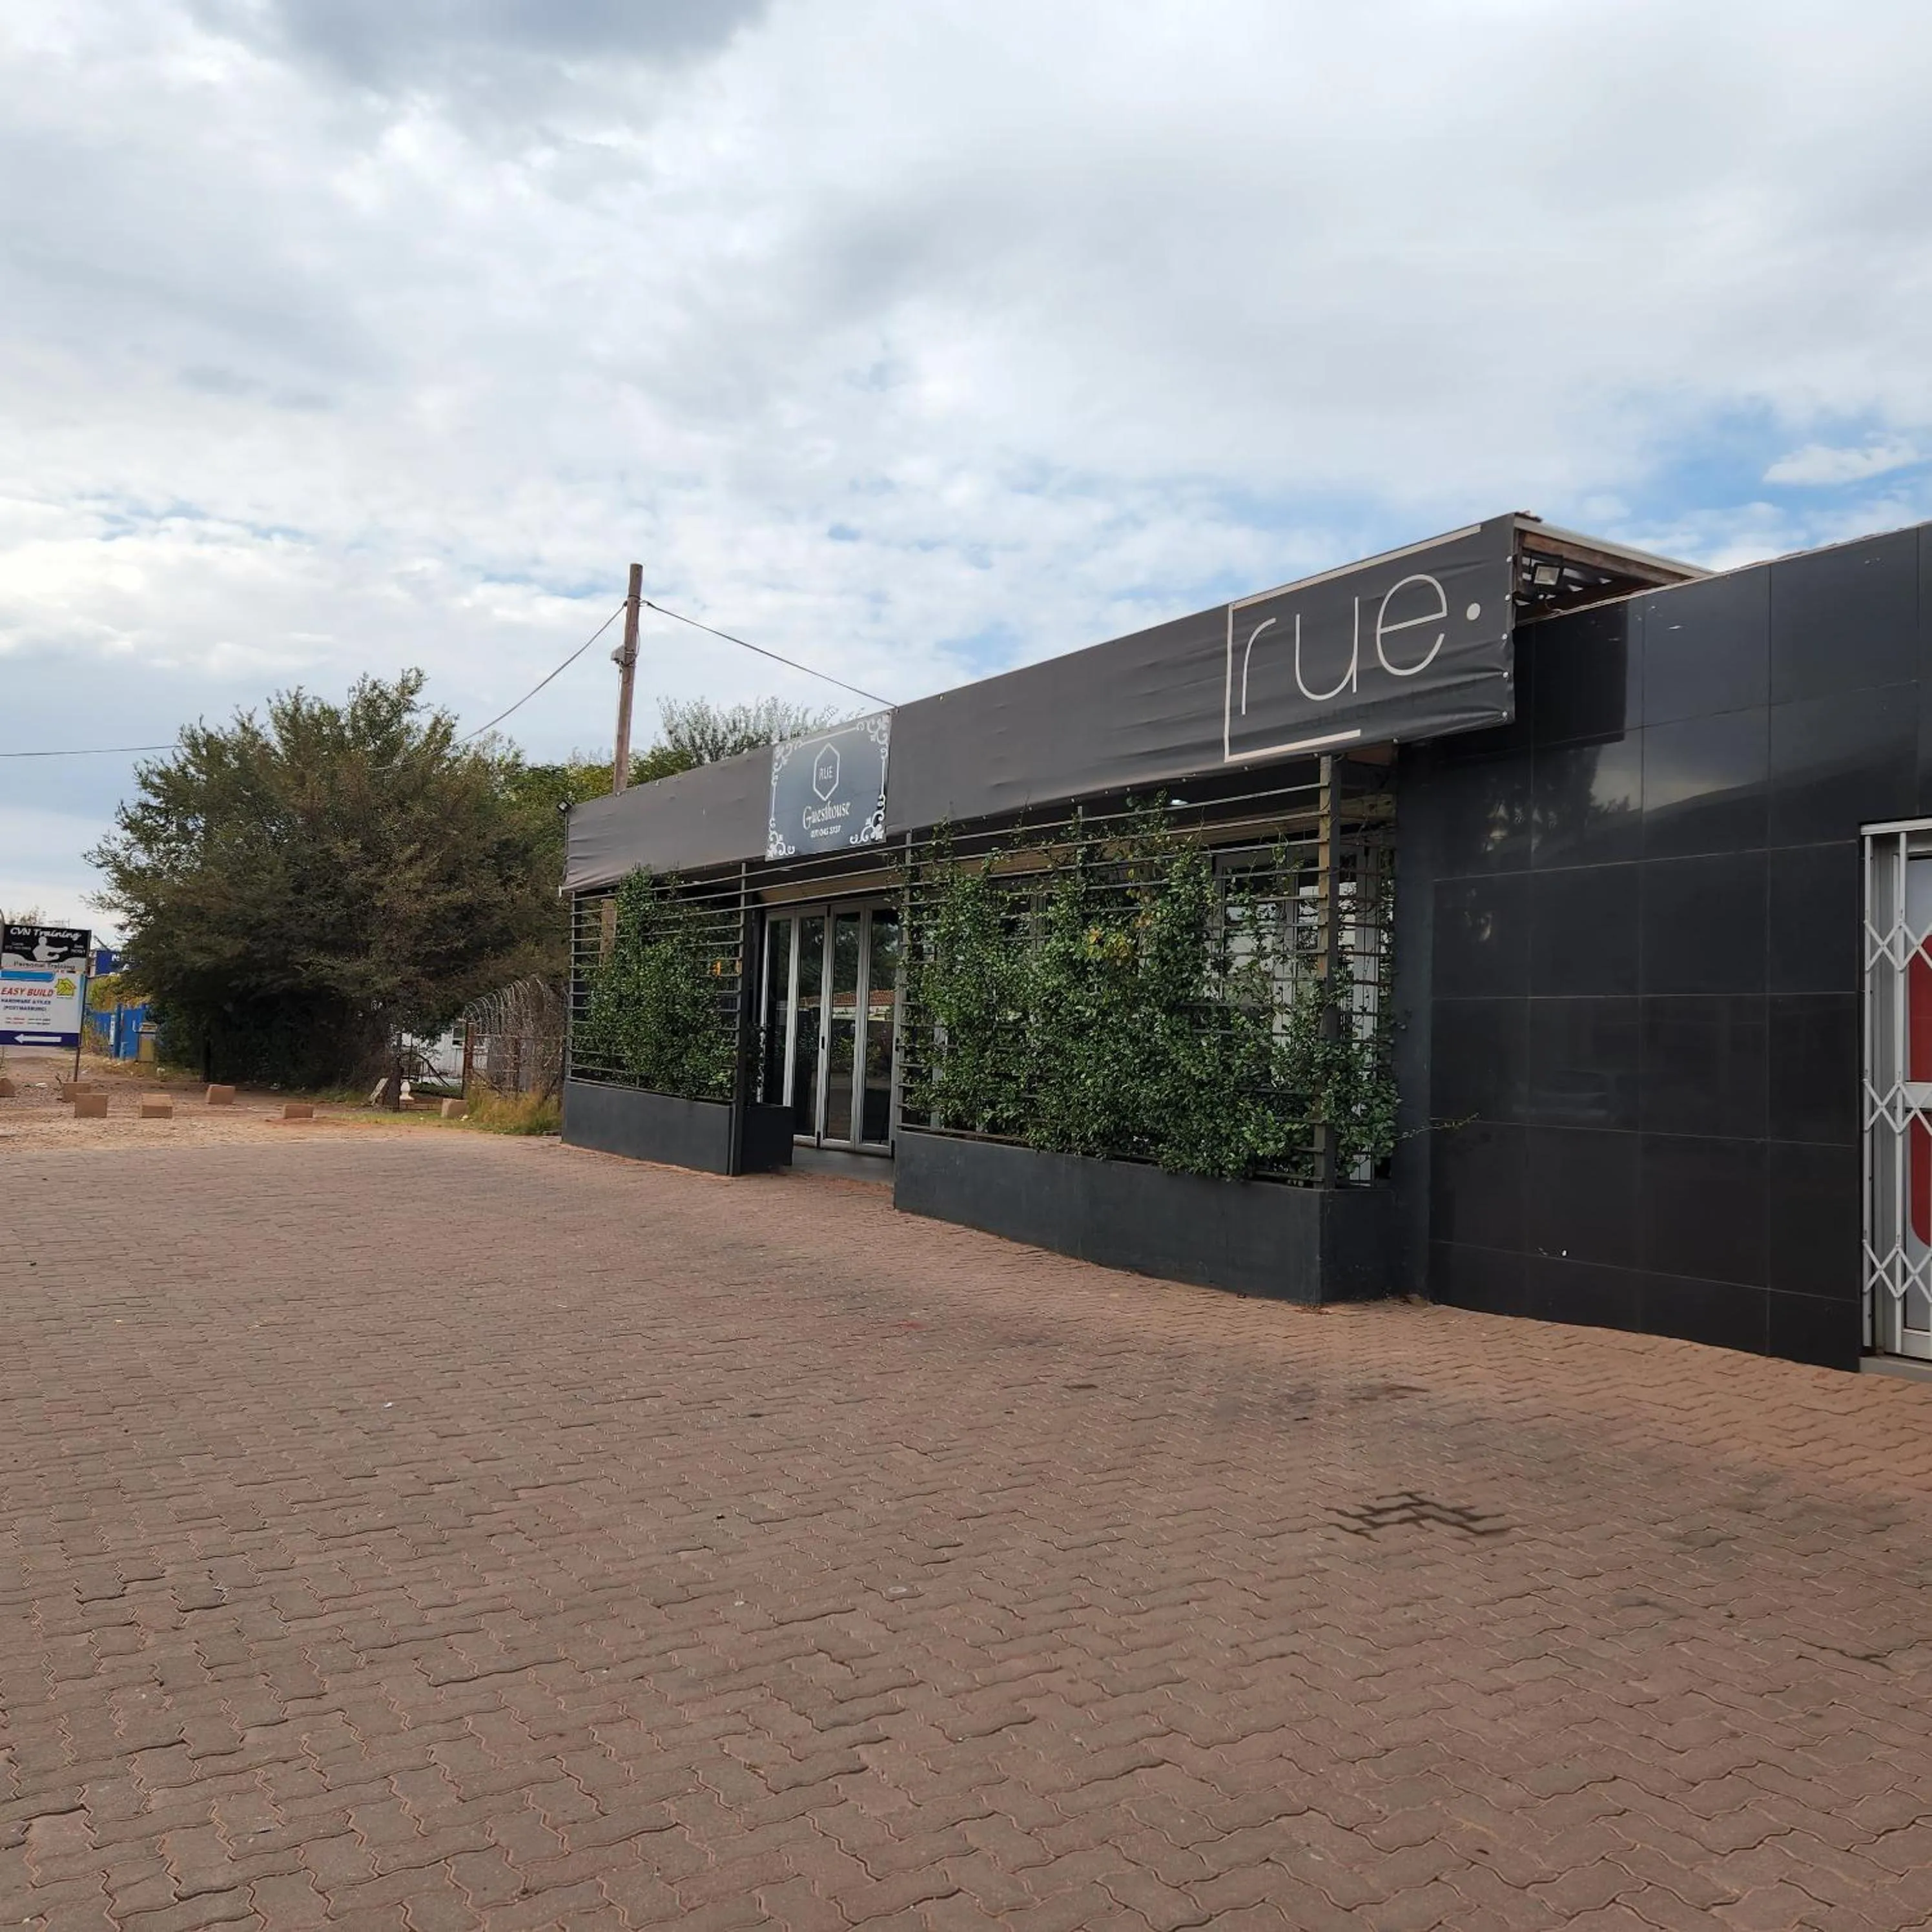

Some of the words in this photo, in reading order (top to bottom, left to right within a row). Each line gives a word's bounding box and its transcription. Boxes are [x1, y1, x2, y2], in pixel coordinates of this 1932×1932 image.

[1240, 573, 1481, 715] rue.
[819, 766, 833, 780] RUE
[803, 801, 850, 830] Guesthouse
[10, 927, 30, 936] CVN
[34, 929, 81, 941] Training
